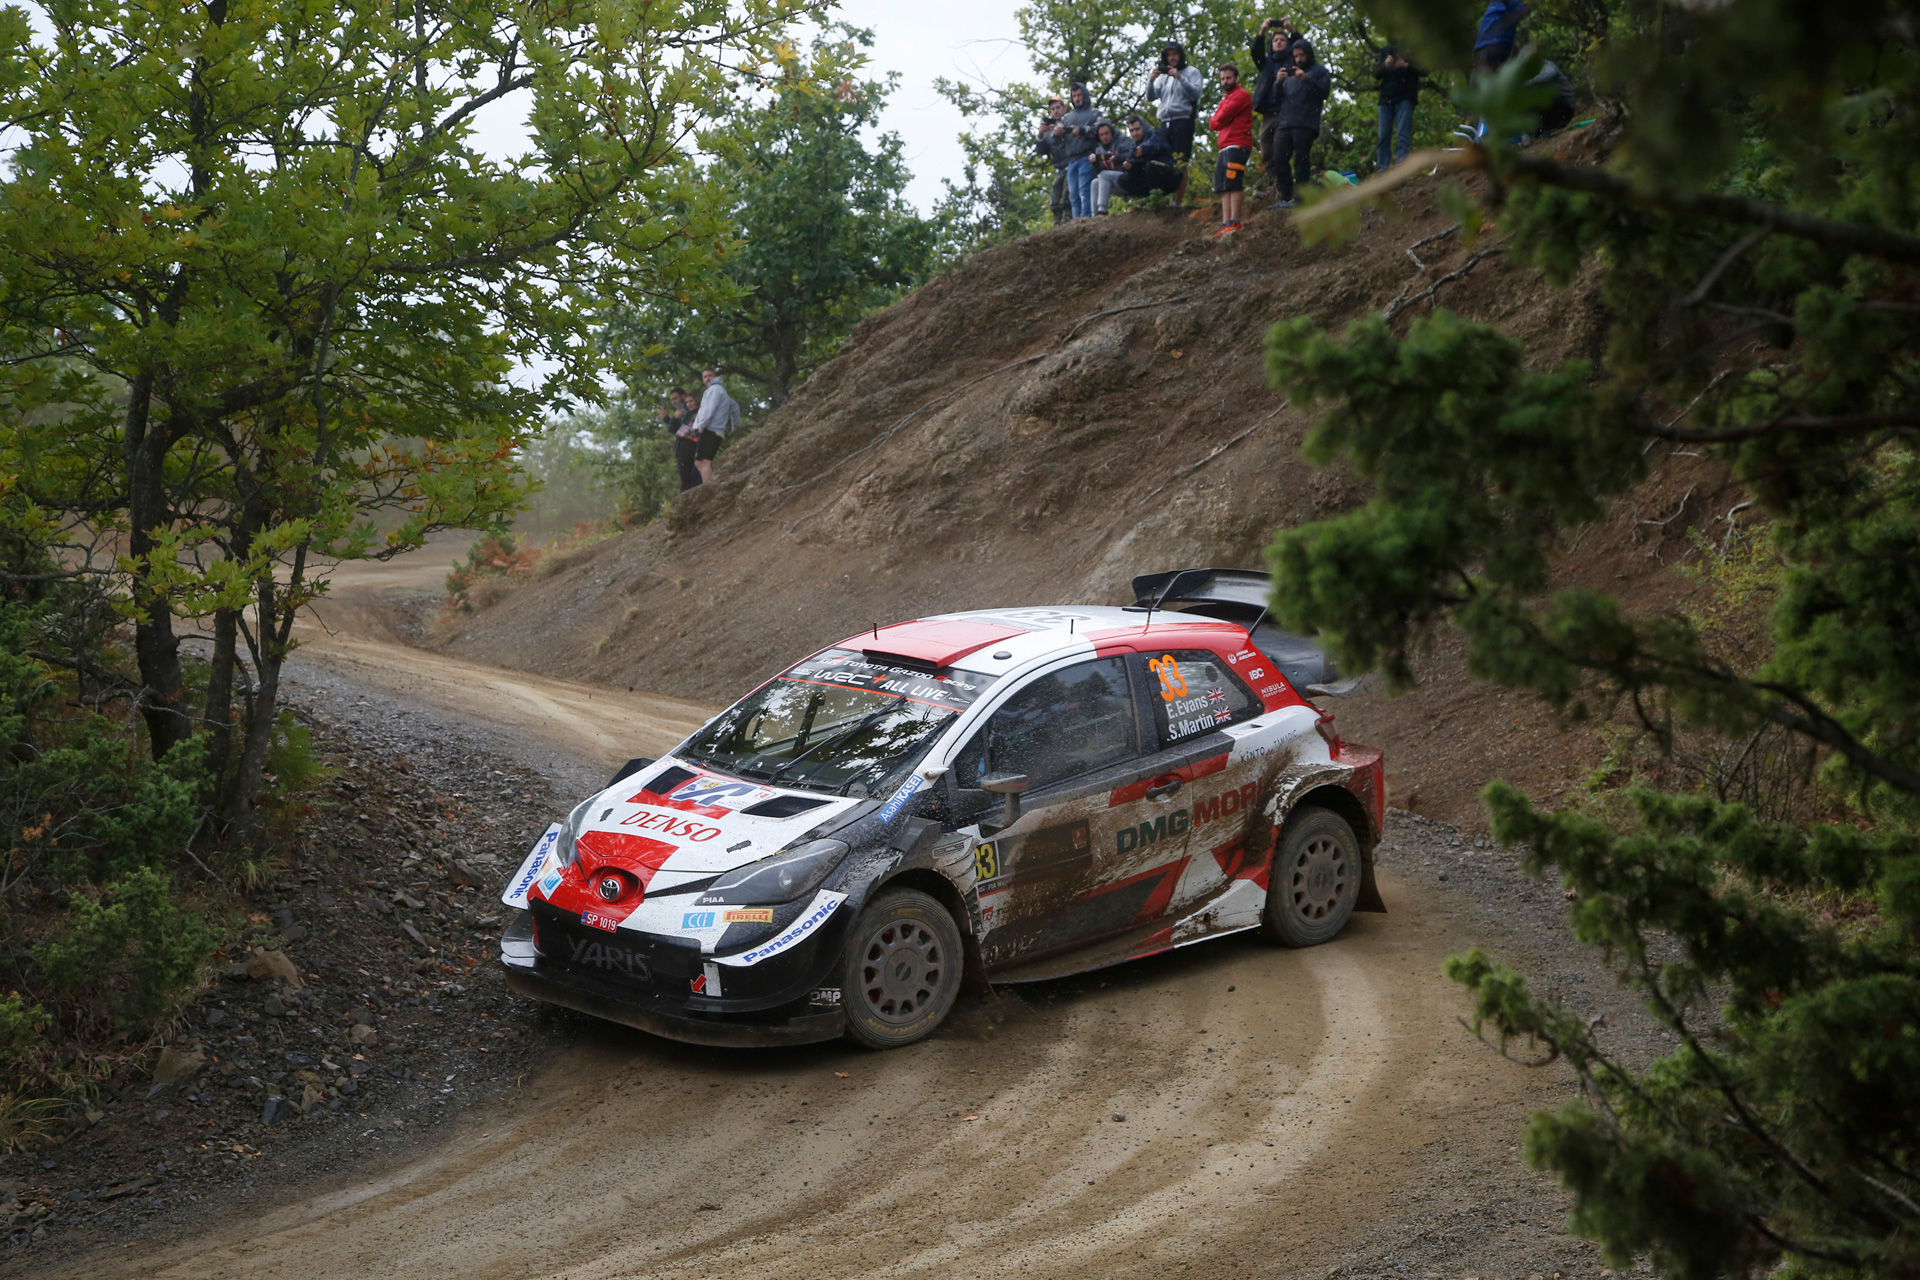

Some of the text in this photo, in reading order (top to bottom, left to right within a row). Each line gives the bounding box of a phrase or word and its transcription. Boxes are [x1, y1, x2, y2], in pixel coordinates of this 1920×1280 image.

[843, 660, 888, 671] TOYOTA
[889, 666, 934, 680] GAZOO
[933, 675, 977, 691] Racing
[1149, 654, 1188, 702] 33
[1261, 682, 1285, 695] NISULA
[879, 680, 907, 694] ALL
[911, 686, 949, 701] LIVE
[1165, 695, 1209, 719] E.Evans
[1168, 713, 1215, 741] S.Martin
[618, 810, 722, 842] DENSO
[1116, 777, 1263, 856] DMG MORI
[509, 831, 559, 899] Panasonic
[702, 896, 725, 904] PIAA
[586, 913, 617, 931] SP 1019
[726, 910, 769, 921] PIRELLI
[742, 899, 839, 963] Panasonic
